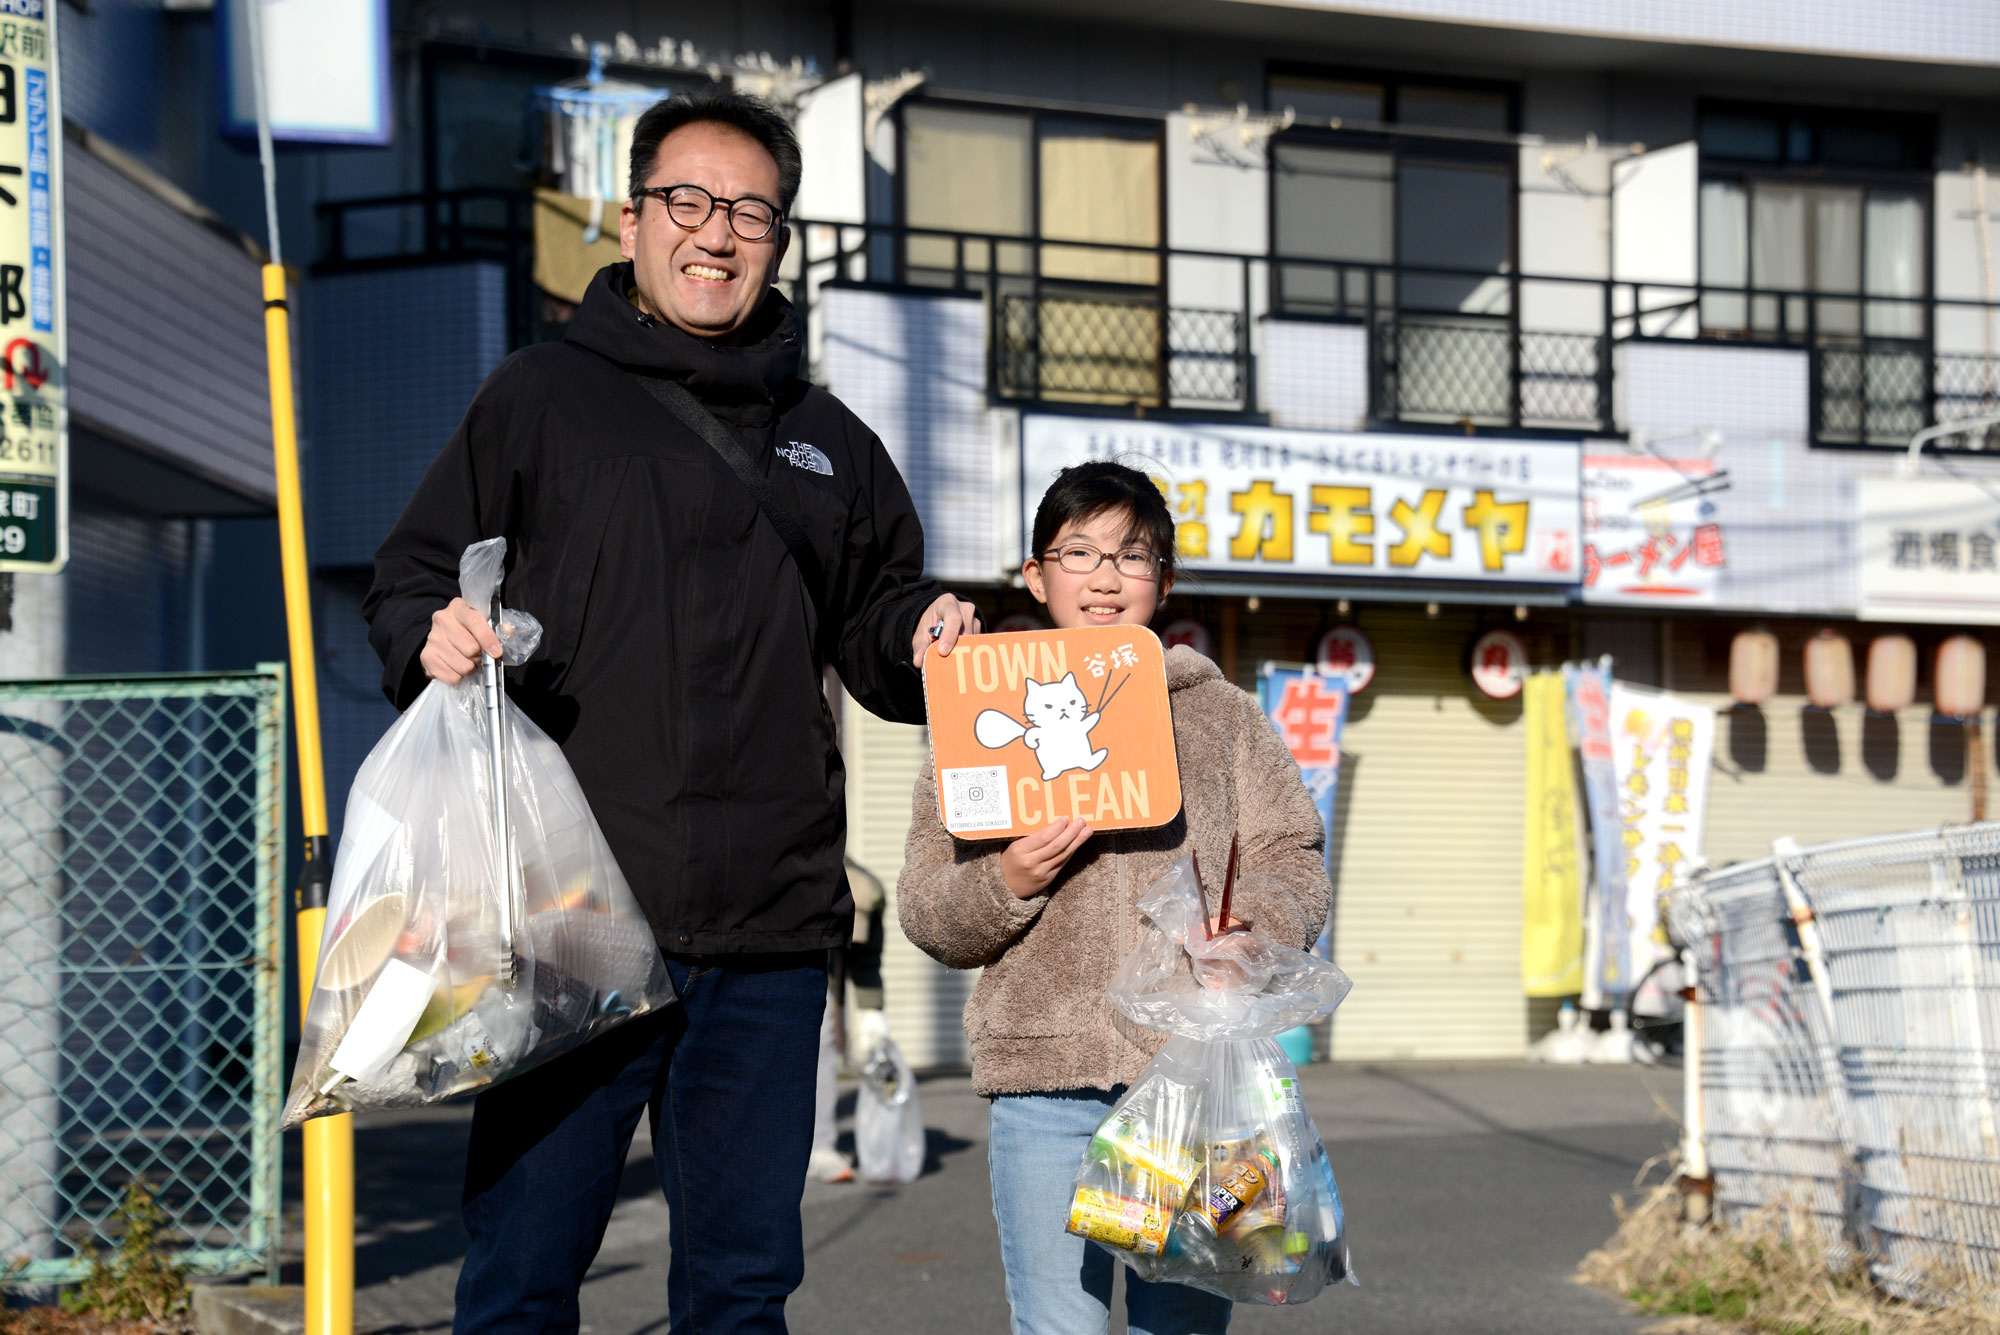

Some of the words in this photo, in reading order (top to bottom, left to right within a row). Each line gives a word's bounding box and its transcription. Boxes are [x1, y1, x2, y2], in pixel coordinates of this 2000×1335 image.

[775, 446, 815, 462] NORTH
[789, 441, 811, 453] THE
[789, 457, 816, 472] FACE
[1229, 480, 1531, 571] カモメヤ
[950, 640, 1067, 694] TOWN
[1083, 643, 1139, 678] 谷塚
[1016, 770, 1151, 826] CLEAN
[1210, 1184, 1239, 1210] UPER
